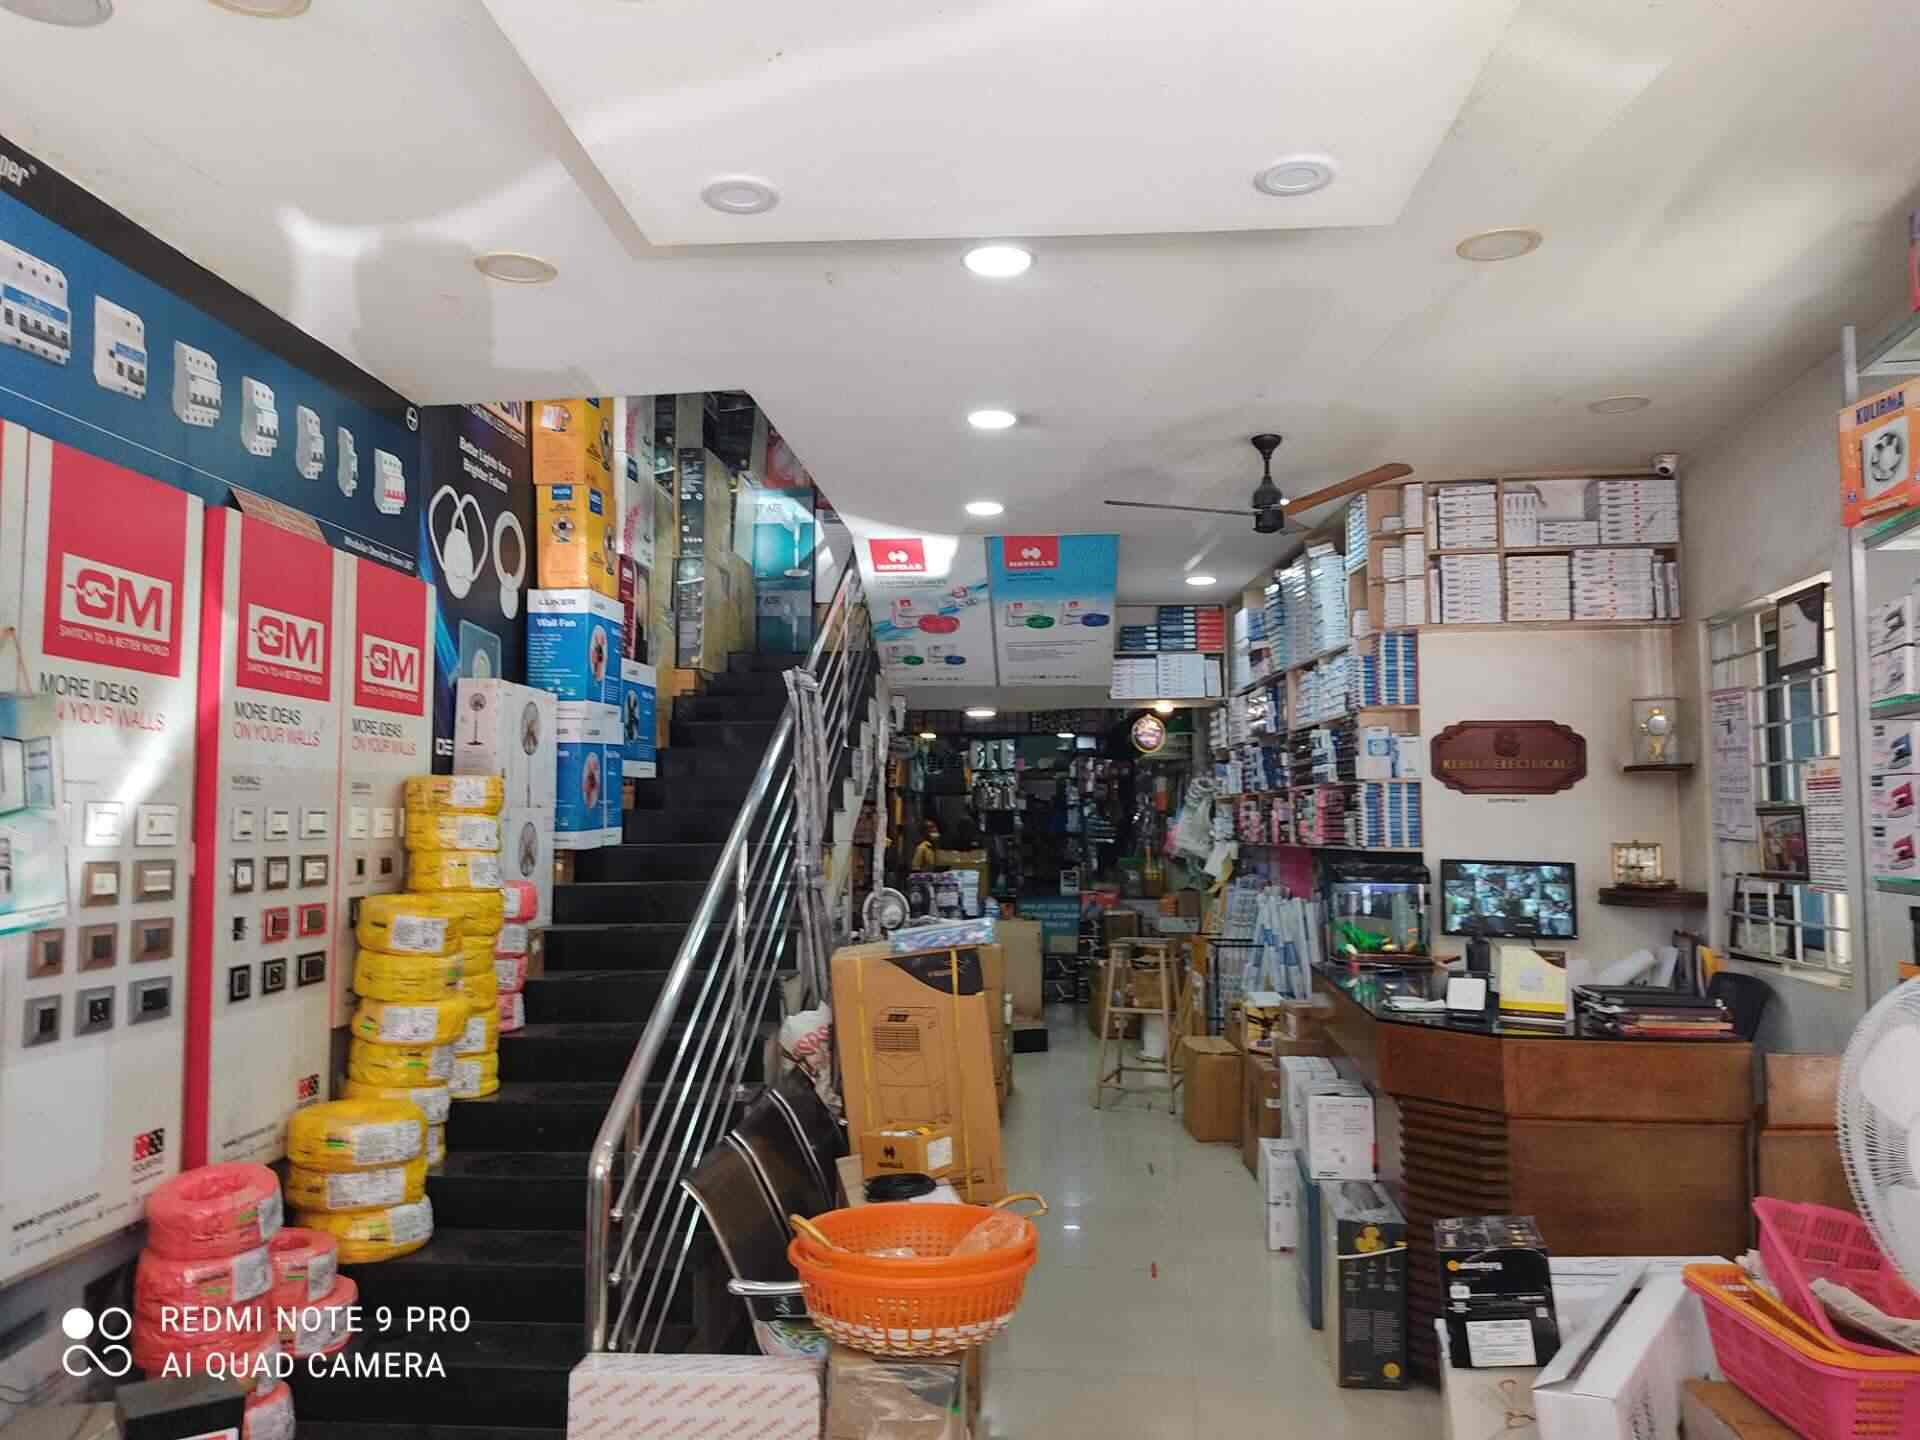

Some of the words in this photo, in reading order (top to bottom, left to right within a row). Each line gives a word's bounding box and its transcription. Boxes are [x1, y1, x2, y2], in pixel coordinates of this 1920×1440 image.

[76, 568, 164, 632] GM
[536, 617, 560, 628] Wall
[560, 617, 577, 628] Fan
[256, 615, 318, 665] GM
[368, 643, 415, 686] GM
[40, 672, 89, 699] MORE
[93, 680, 139, 706] IDEAS
[69, 703, 113, 726] YOUR
[118, 707, 166, 732] WALLS
[234, 700, 267, 722] MORE
[271, 705, 301, 726] IDEAS
[352, 717, 377, 735] MORE
[379, 721, 403, 738] IDEAS
[233, 721, 249, 740] ON
[250, 722, 284, 744] YOUR
[286, 726, 320, 748] WALLS
